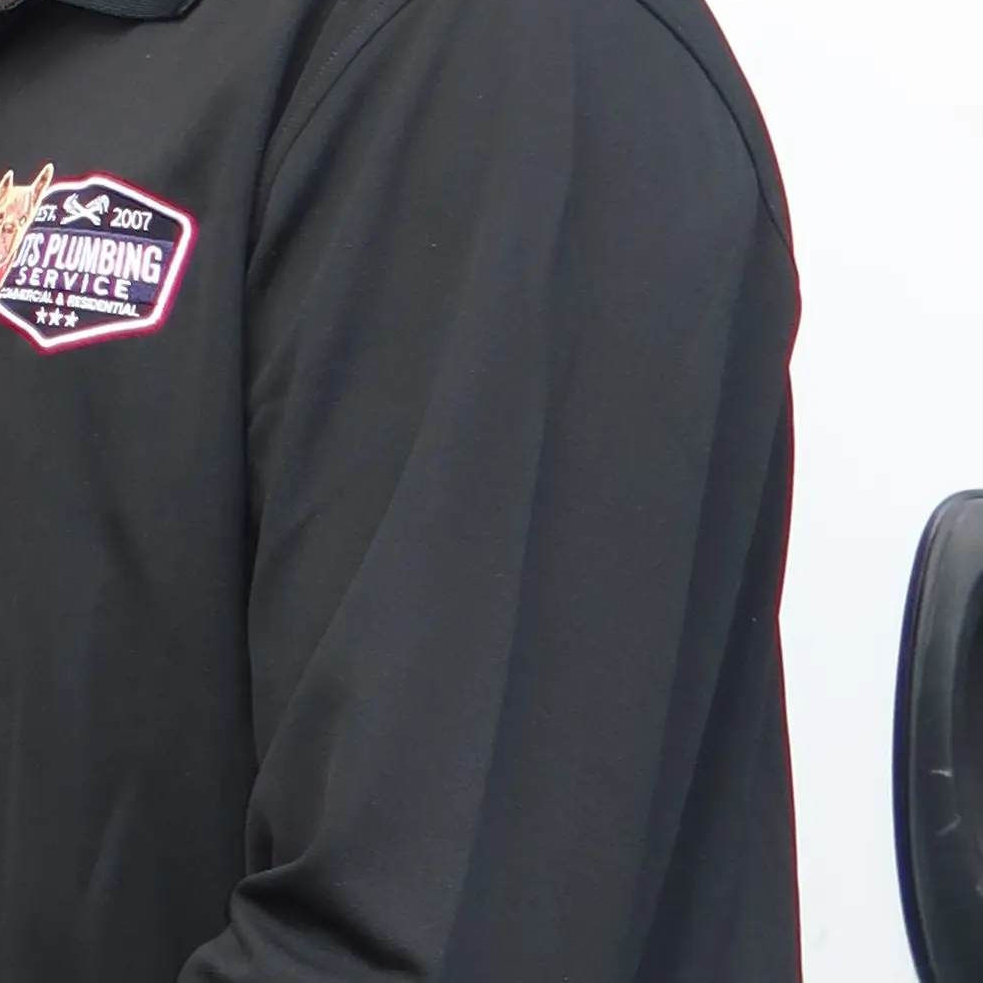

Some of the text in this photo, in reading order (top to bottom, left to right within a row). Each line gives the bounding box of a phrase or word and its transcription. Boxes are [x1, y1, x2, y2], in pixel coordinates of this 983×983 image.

[110, 208, 153, 232] 2007
[41, 233, 163, 285] PLUMBING
[15, 266, 132, 301] SERVICE
[55, 292, 65, 306] &
[66, 294, 140, 318] RESIDENTIAL
